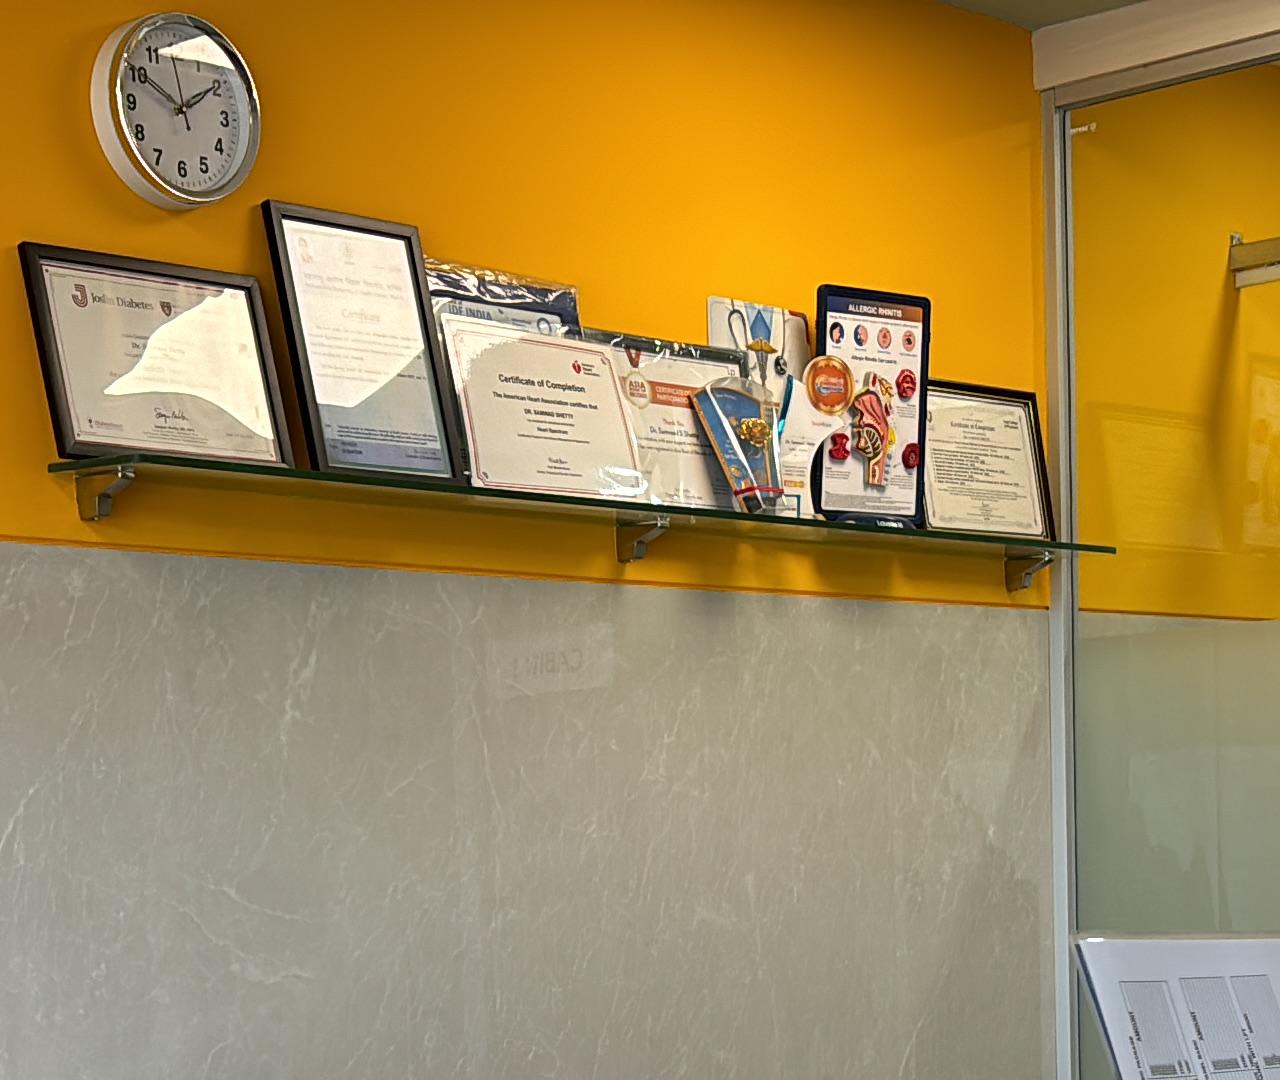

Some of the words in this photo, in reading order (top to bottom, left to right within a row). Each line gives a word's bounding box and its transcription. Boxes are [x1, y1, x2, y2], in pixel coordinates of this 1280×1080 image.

[146, 45, 160, 64] 11
[129, 66, 147, 84] 10
[212, 79, 221, 97] 2
[127, 93, 137, 111] 9
[220, 111, 229, 127] 3
[135, 124, 145, 141] 8
[214, 138, 223, 155] 4
[153, 148, 163, 166] 7
[199, 156, 209, 174] 5
[177, 161, 187, 178] 6
[848, 304, 877, 315] ALLERGIC
[498, 373, 535, 387] Certificate
[537, 379, 544, 387] of
[546, 380, 586, 394] Completion
[1128, 1011, 1142, 1042] AMOUNT
[1190, 1012, 1204, 1041] AMOUNT
